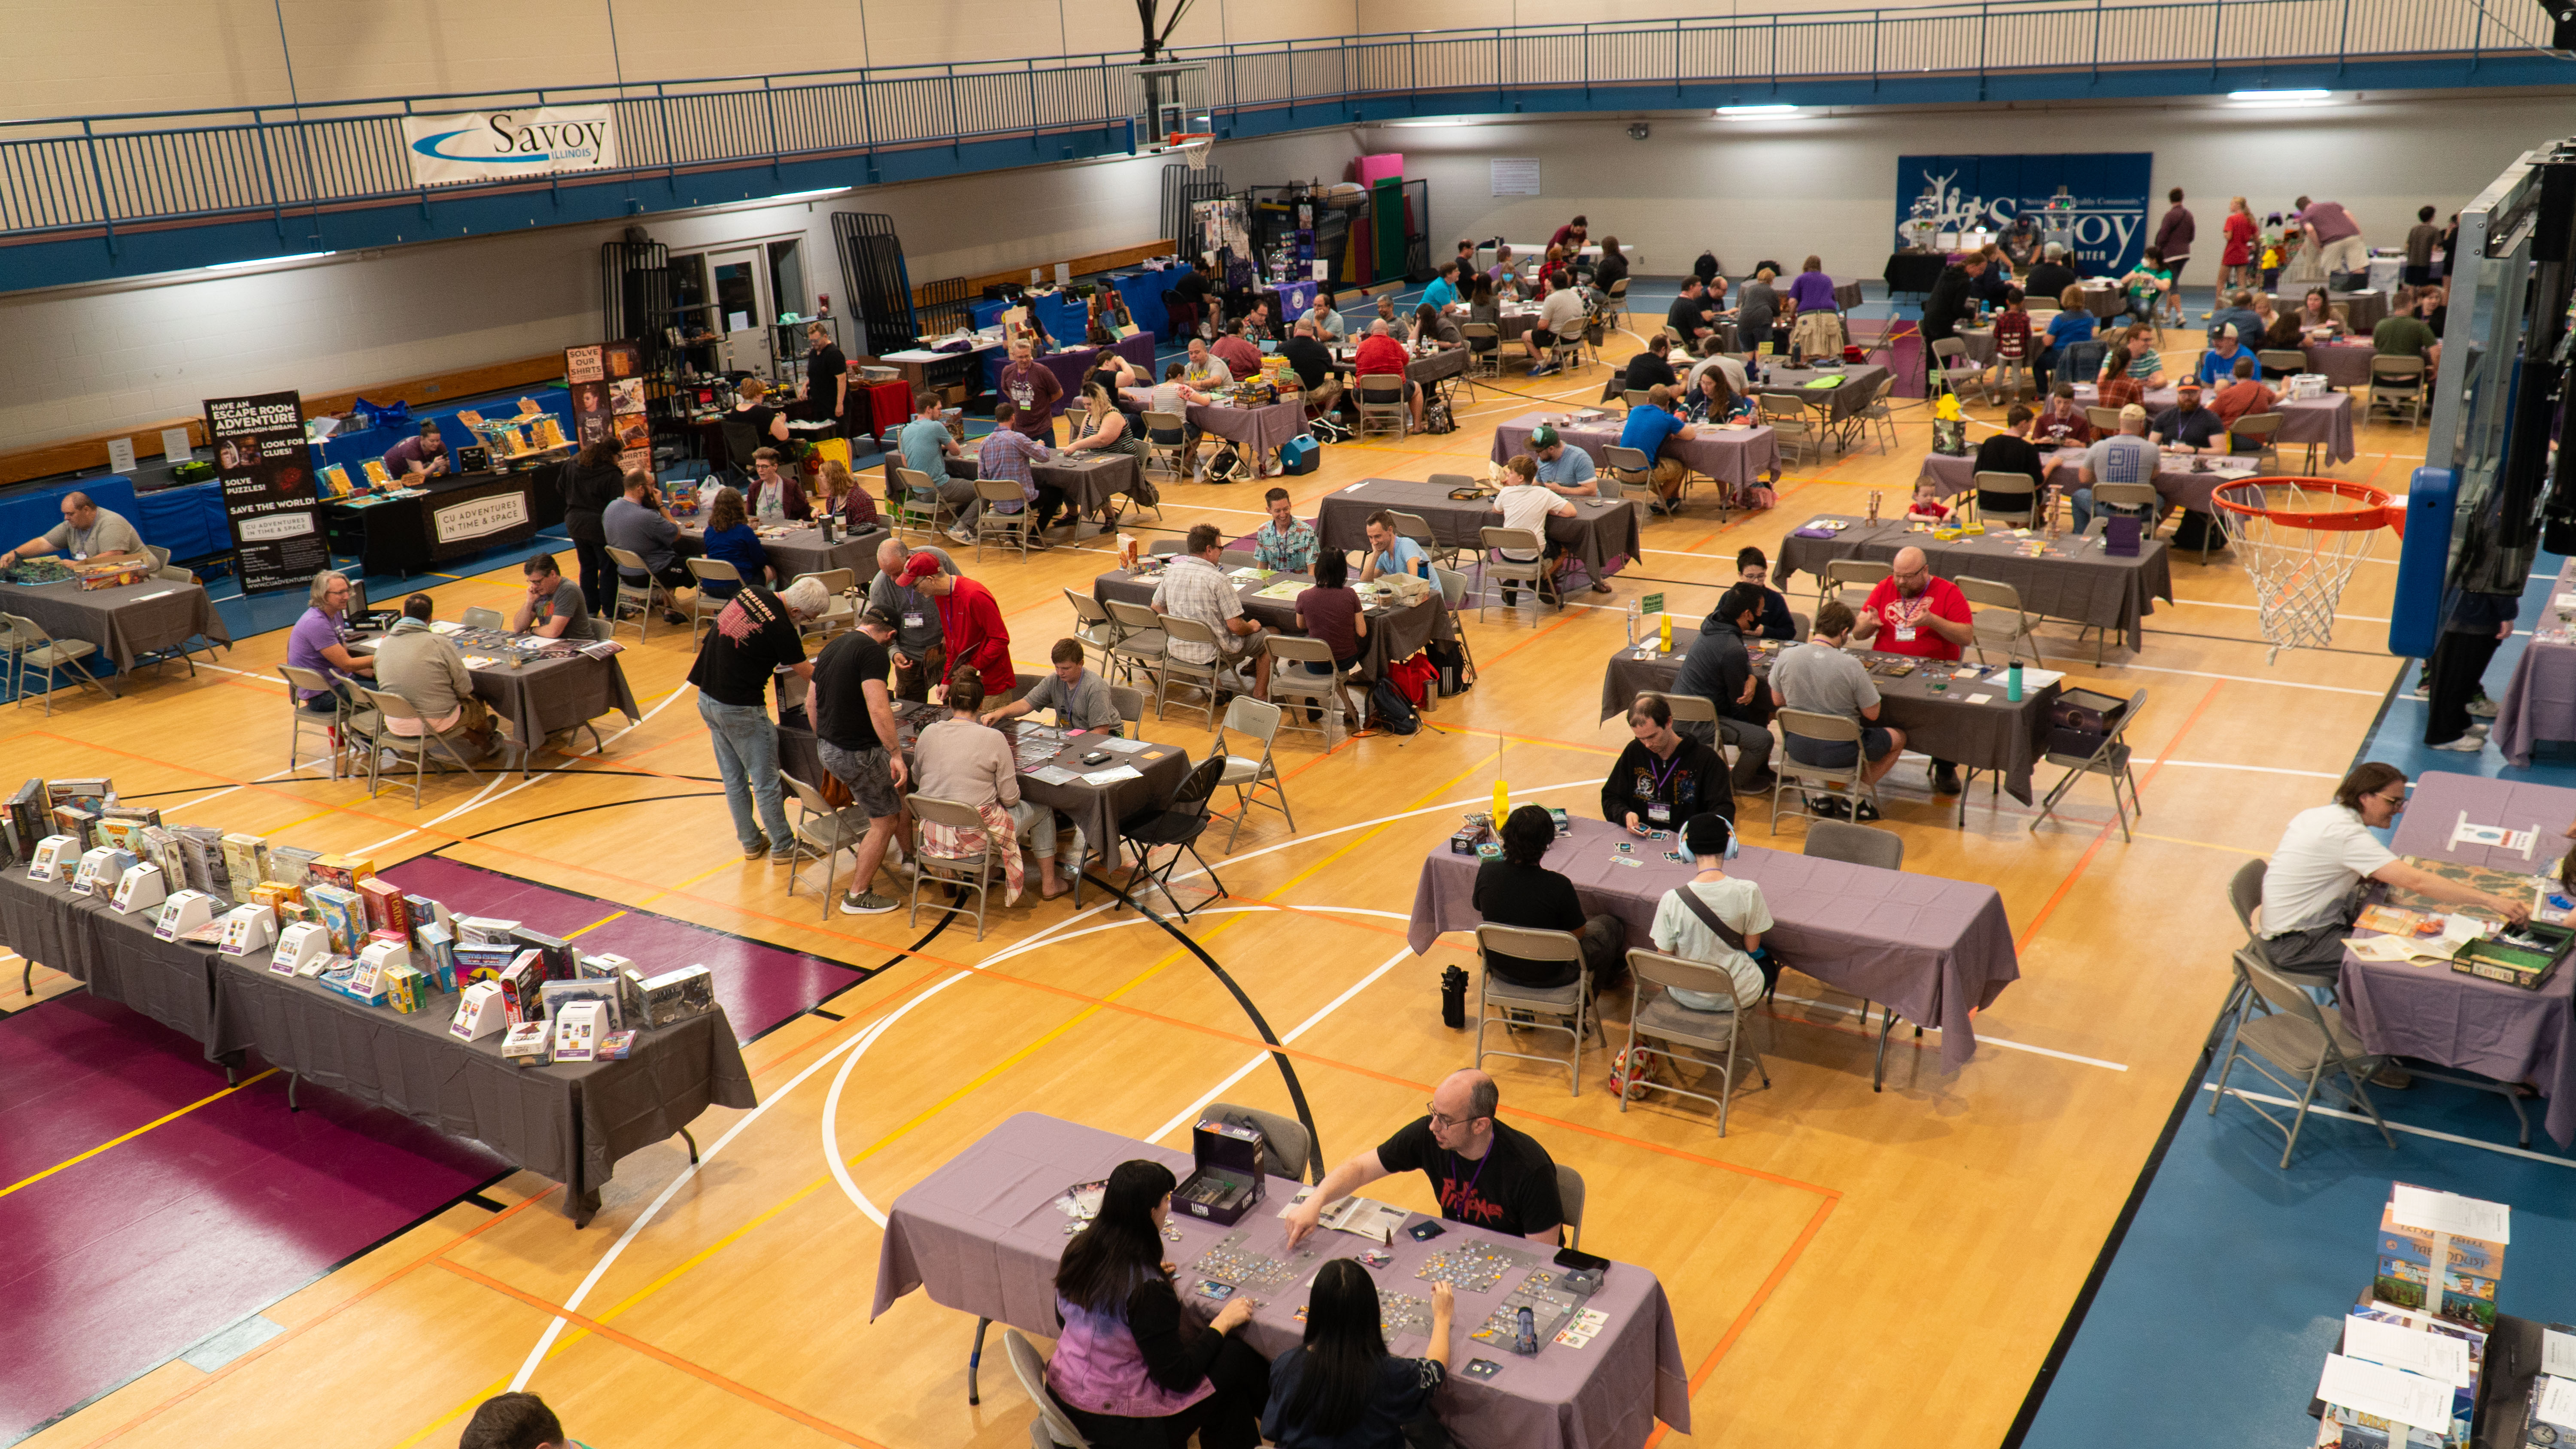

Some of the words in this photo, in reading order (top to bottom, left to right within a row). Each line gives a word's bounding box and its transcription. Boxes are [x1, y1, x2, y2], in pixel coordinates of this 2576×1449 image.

[489, 114, 605, 164] Savoy
[551, 148, 591, 160] ILLINOIS
[570, 349, 598, 358] SOLVE
[576, 358, 595, 366] OUR
[571, 366, 601, 376] SHIRTS
[211, 403, 234, 411] HAVE
[213, 407, 258, 420] ESCAPE
[259, 404, 294, 416] ROOM
[216, 412, 297, 430] ADVENTURE
[225, 423, 298, 436] CHAMPAIGN-URBANA
[261, 440, 286, 449] LOOK
[263, 448, 292, 457] CLUES!
[225, 477, 252, 487] SOLVE
[227, 484, 266, 495] PUZZLES!
[230, 505, 255, 515] SAVE
[255, 502, 276, 511] THE
[276, 497, 316, 508] WORLD!
[443, 515, 455, 523] CU
[459, 500, 516, 520] ADVENTURES
[258, 518, 305, 528] ADVENTURES
[284, 523, 306, 531] SPACE
[446, 525, 454, 534] IN
[458, 519, 479, 530] TIME
[491, 510, 518, 523] SPACE
[755, 612, 766, 622] 2022
[392, 900, 403, 925] CATAN
[468, 954, 480, 963] TOP
[482, 954, 499, 964] GUN
[2412, 1244, 2485, 1267] TABNUSI
